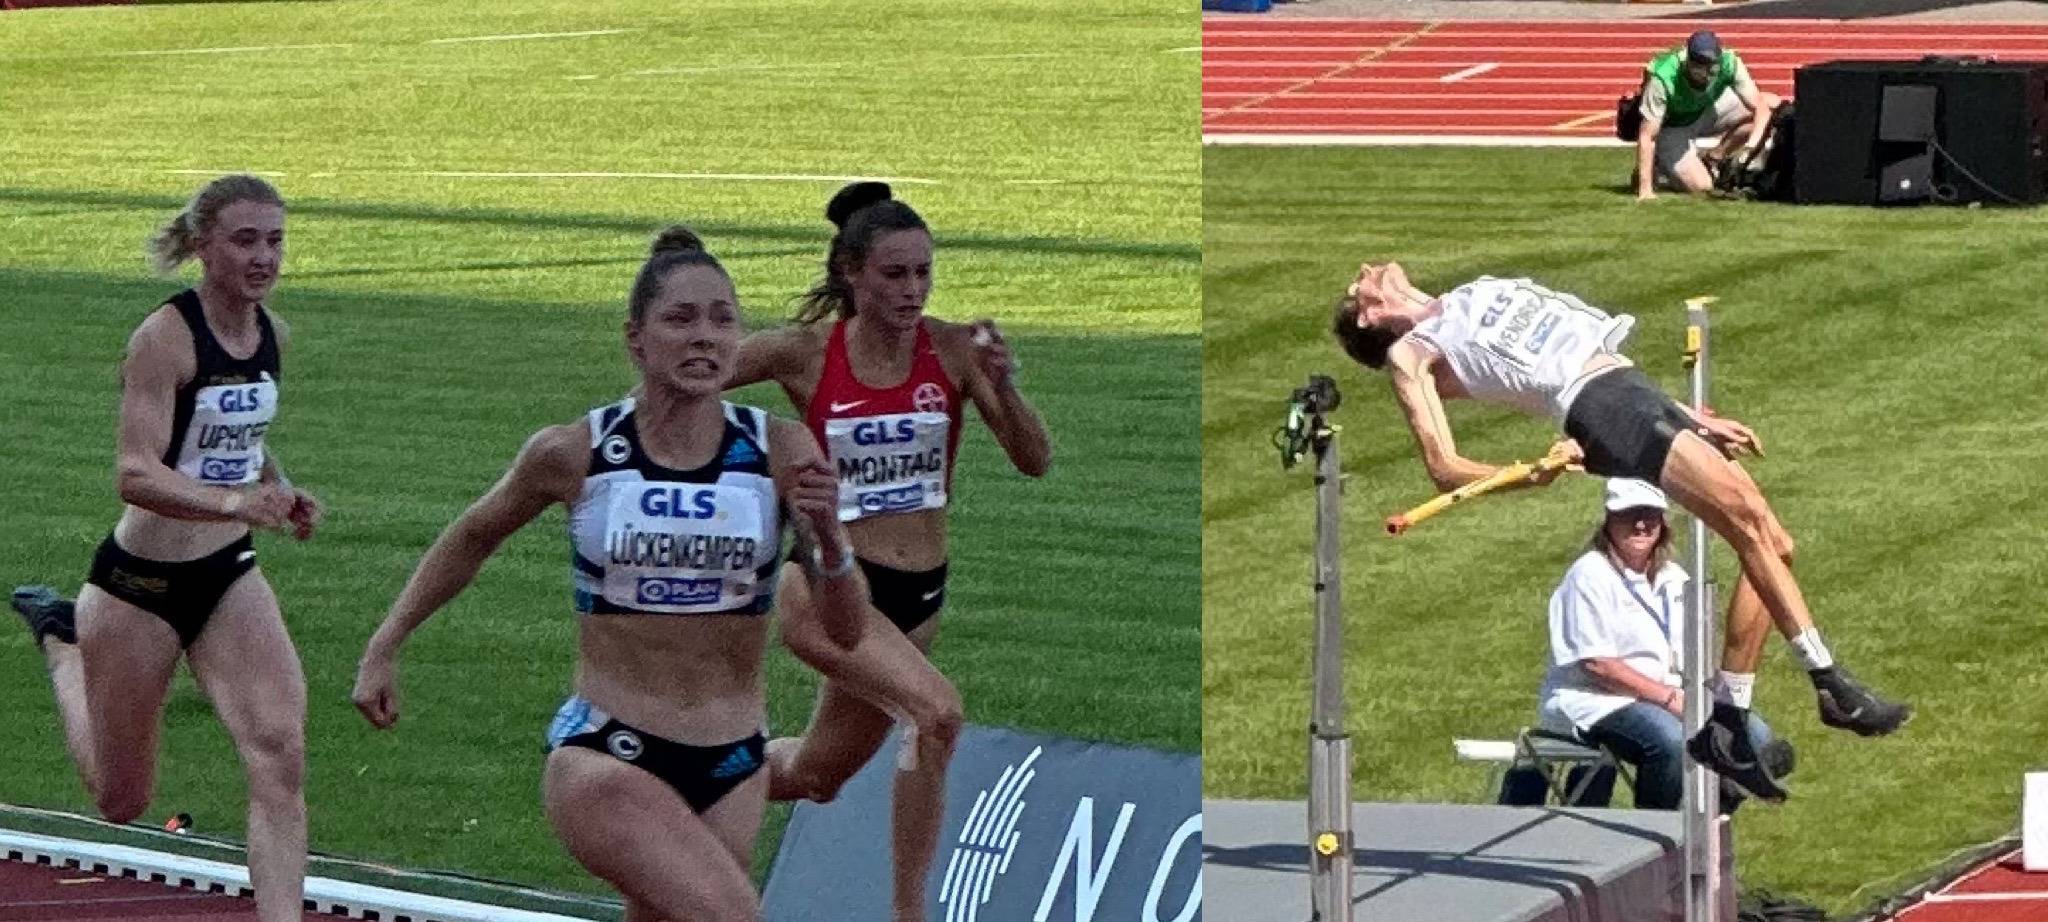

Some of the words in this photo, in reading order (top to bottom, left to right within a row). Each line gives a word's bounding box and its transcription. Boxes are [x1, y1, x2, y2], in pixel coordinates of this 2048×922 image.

[219, 387, 259, 413] GLS
[853, 419, 915, 446] GLS
[836, 448, 942, 484] MONTAG
